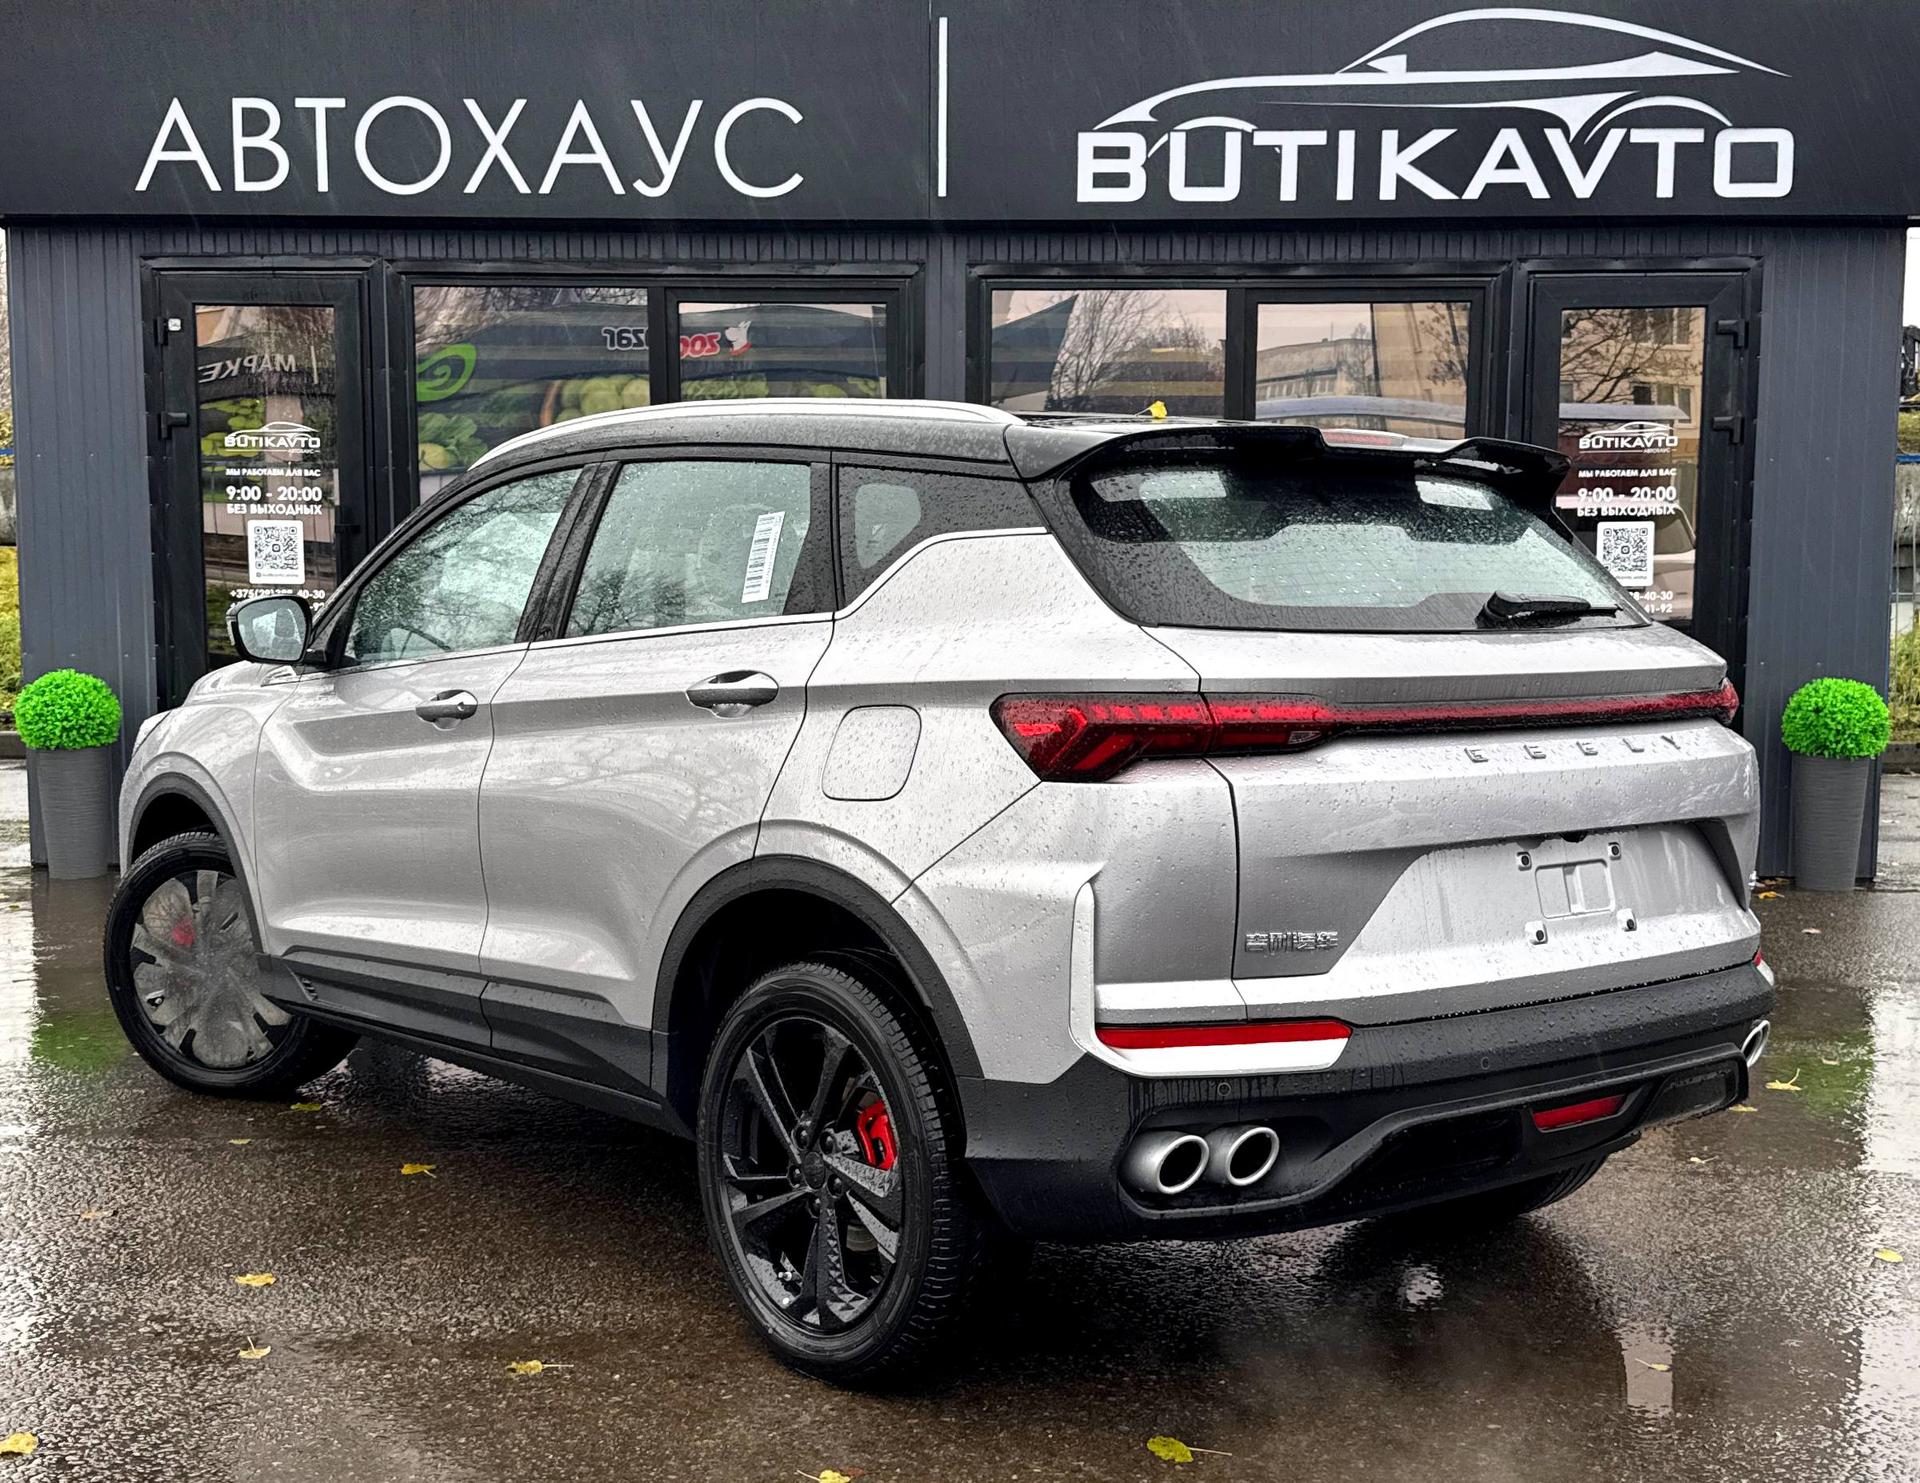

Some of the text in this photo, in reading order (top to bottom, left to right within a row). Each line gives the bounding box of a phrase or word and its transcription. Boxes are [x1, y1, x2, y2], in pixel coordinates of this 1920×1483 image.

[135, 96, 803, 198] АВТОХАУС
[1077, 127, 1795, 202] BUTIKAVTO
[224, 435, 321, 448] BUTIKAVTO
[1578, 435, 1679, 449] BUTIKAVTO
[225, 468, 321, 477] МЫ РАБОТАЕМ ДЛЯ ВАС
[1578, 468, 1677, 478] МЫ РАБОТАЕМ ДЛЯ ВАС
[225, 486, 261, 501] 9:00
[277, 486, 322, 502] 20:00
[1578, 487, 1614, 502] 9:00
[1630, 486, 1677, 502] 20:00
[227, 503, 323, 516] БЕЗ ВЫХОДНЫХ
[1577, 504, 1676, 517] БЕЗ ВЫХОДНЫХ
[1464, 734, 1682, 763] GEELY
